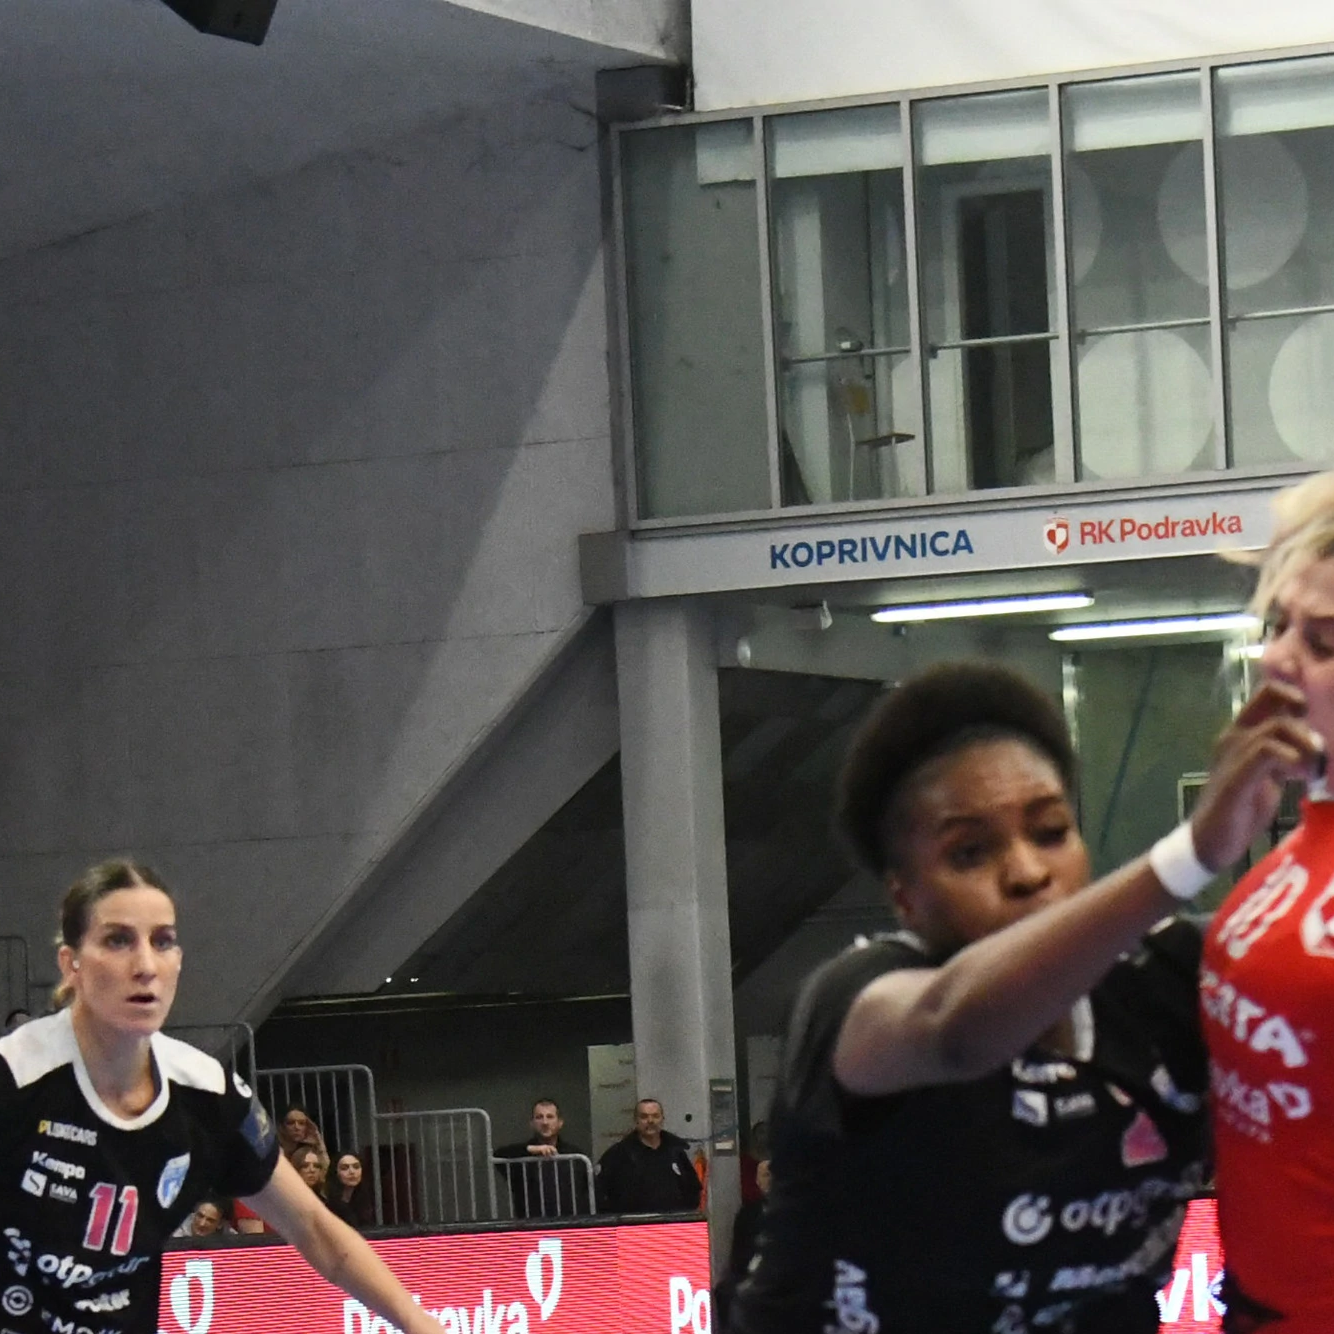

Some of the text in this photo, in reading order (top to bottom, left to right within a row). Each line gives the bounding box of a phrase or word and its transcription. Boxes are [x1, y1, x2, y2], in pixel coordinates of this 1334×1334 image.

[1078, 511, 1243, 546] RK Podravka
[769, 530, 974, 570] KOPRIVNICA
[32, 1151, 86, 1180] Kempa
[83, 1182, 139, 1256] 11
